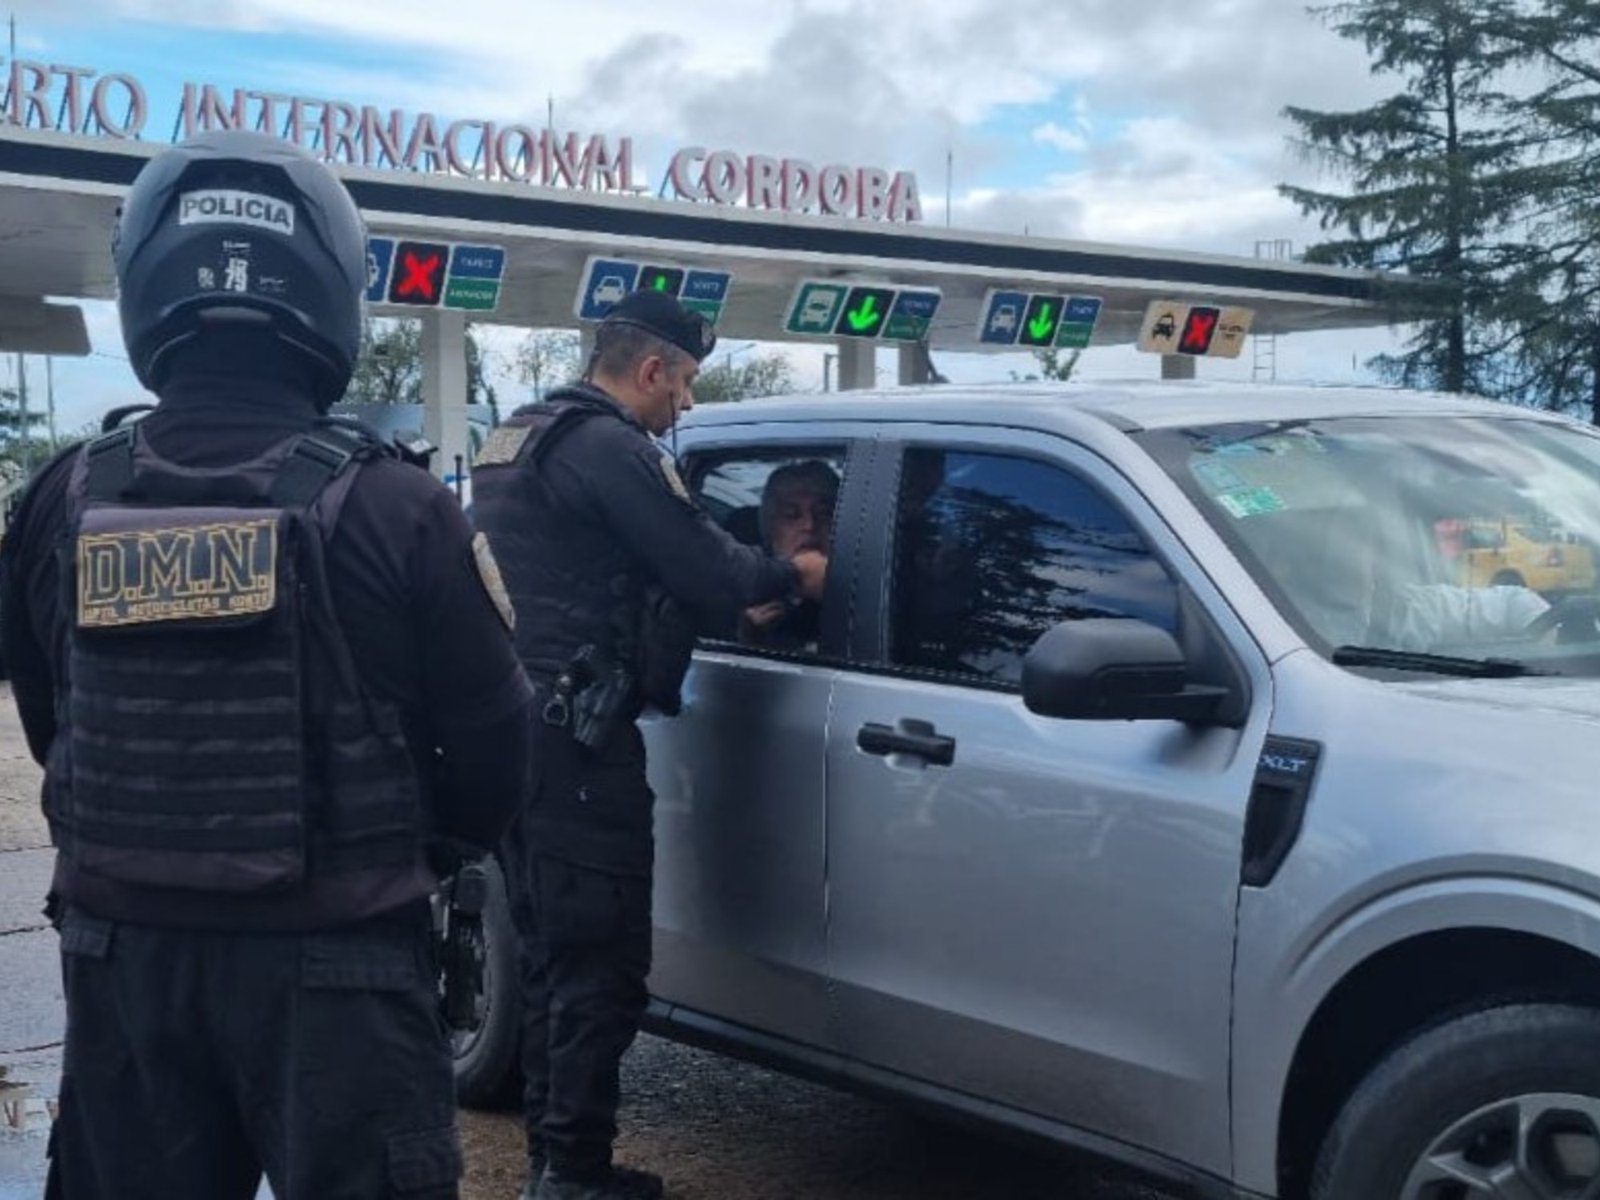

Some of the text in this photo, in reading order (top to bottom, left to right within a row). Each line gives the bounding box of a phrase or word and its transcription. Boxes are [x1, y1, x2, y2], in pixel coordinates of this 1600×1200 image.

[0, 56, 923, 221] RTO INTERNACIONAL CORDOBA
[182, 195, 292, 228] POLICIA
[84, 525, 269, 604] D.M.N.
[1261, 754, 1307, 772] XLT
